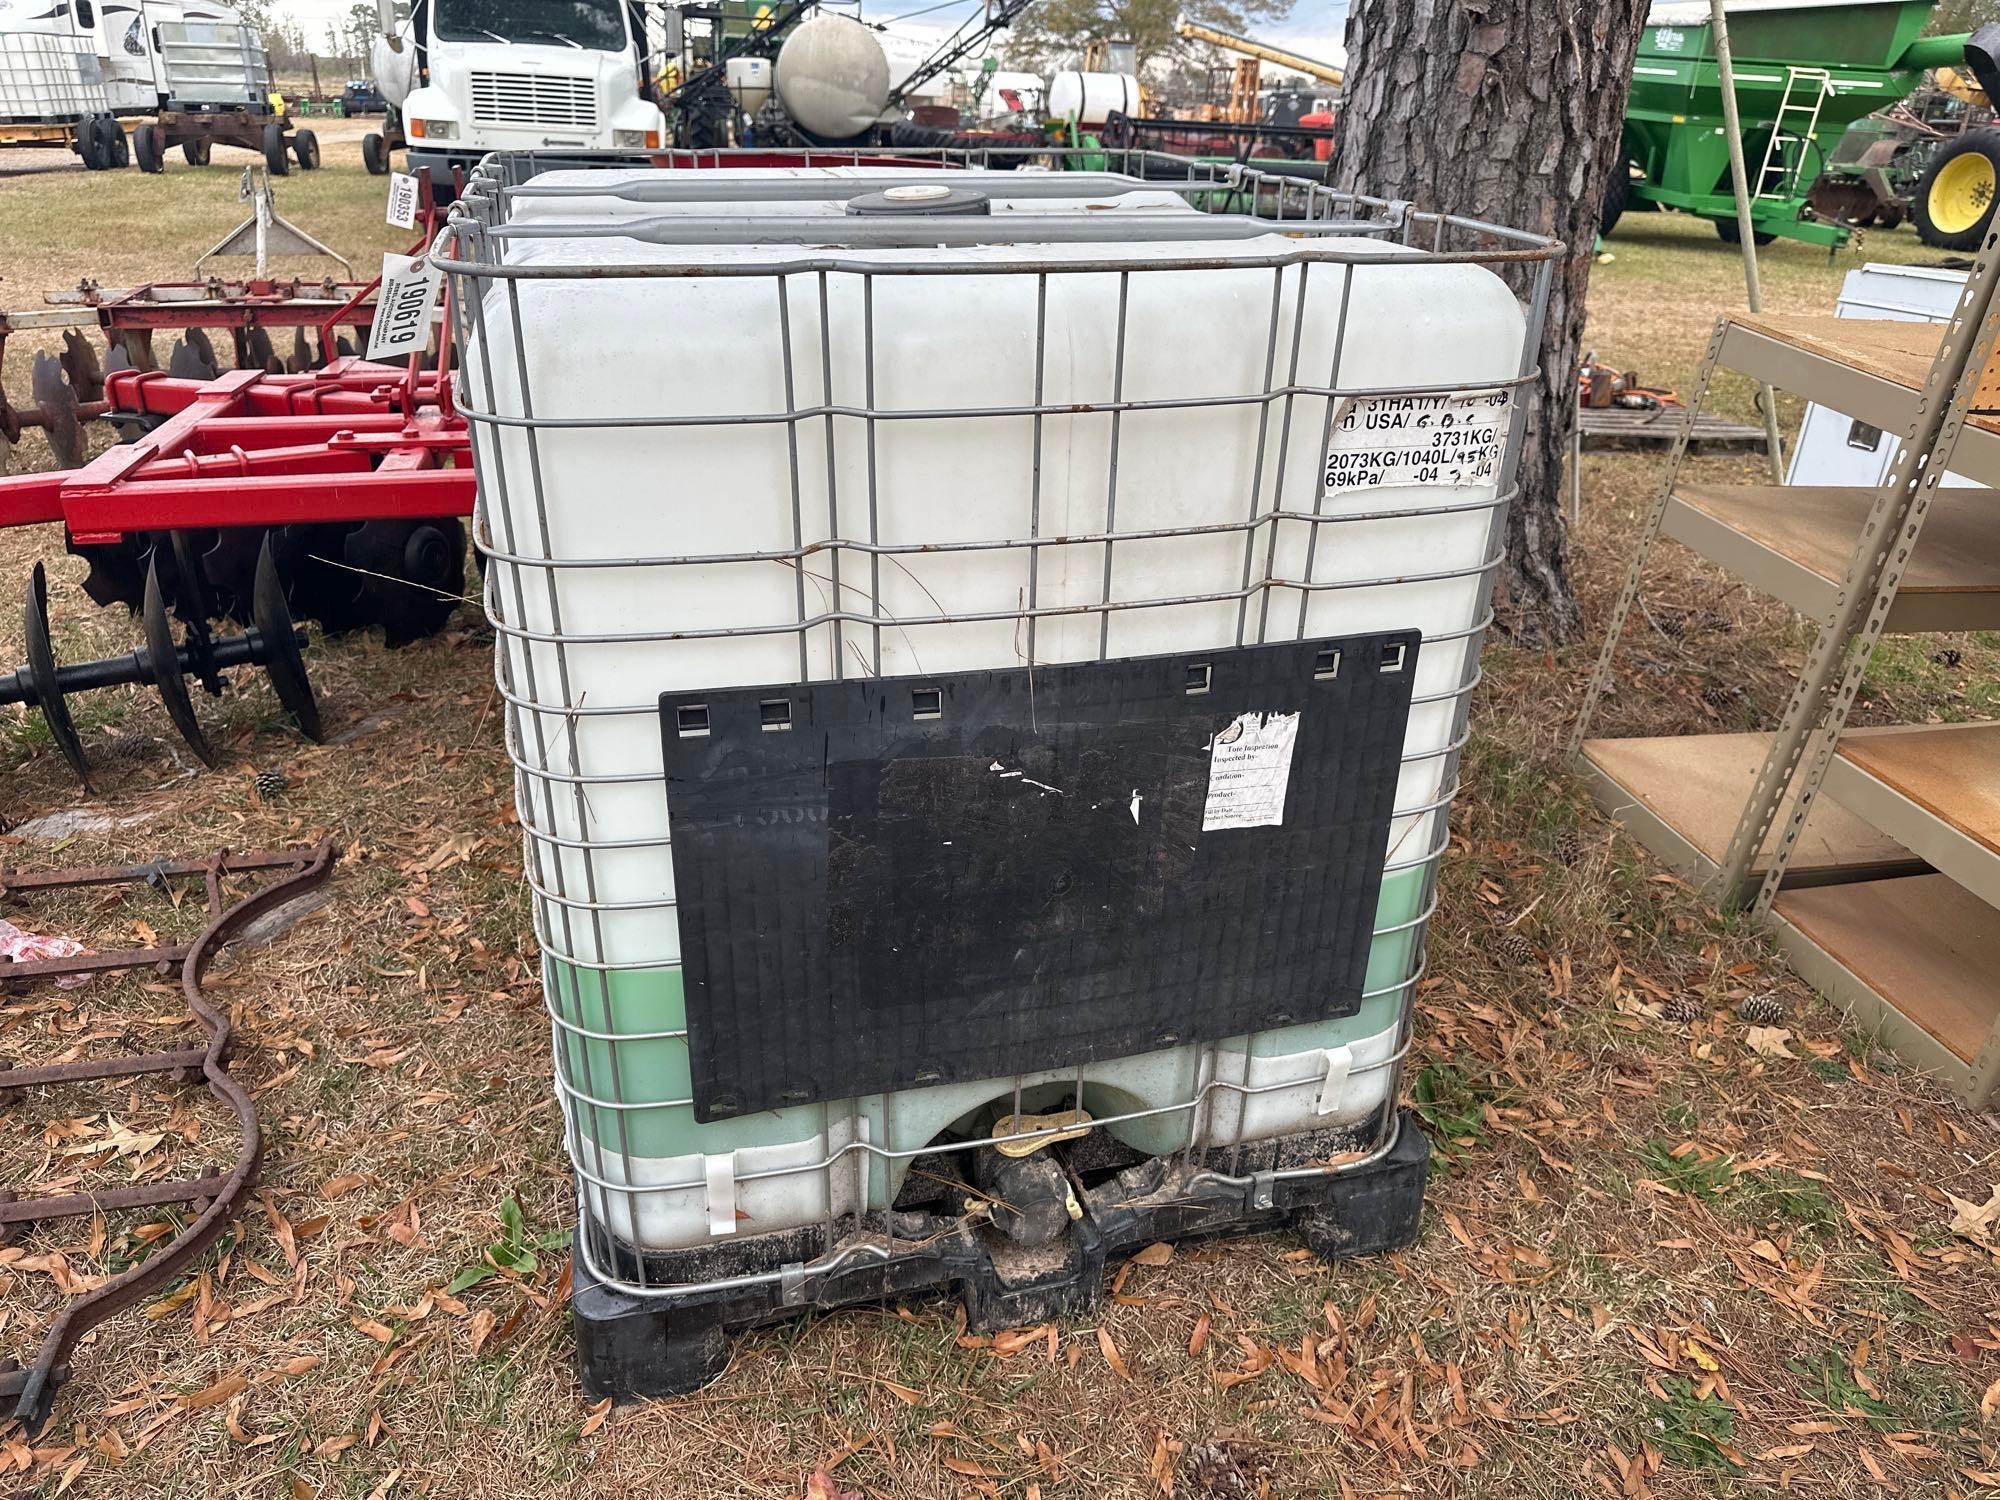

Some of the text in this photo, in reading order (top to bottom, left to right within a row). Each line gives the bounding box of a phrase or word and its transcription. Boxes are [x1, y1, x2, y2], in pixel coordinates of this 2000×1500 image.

[397, 187, 412, 222] 190353
[392, 282, 401, 299] REBEL
[390, 277, 430, 343] 190619
[381, 320, 390, 343] COMPANY
[1366, 413, 1411, 430] USA/
[1432, 427, 1498, 447] 3731KG/
[1325, 469, 1386, 487] 69kPa/
[1413, 467, 1438, 482] -04
[1470, 462, 1492, 477] -04
[1244, 743, 1279, 752] Inspection
[1213, 754, 1246, 763] Inspected
